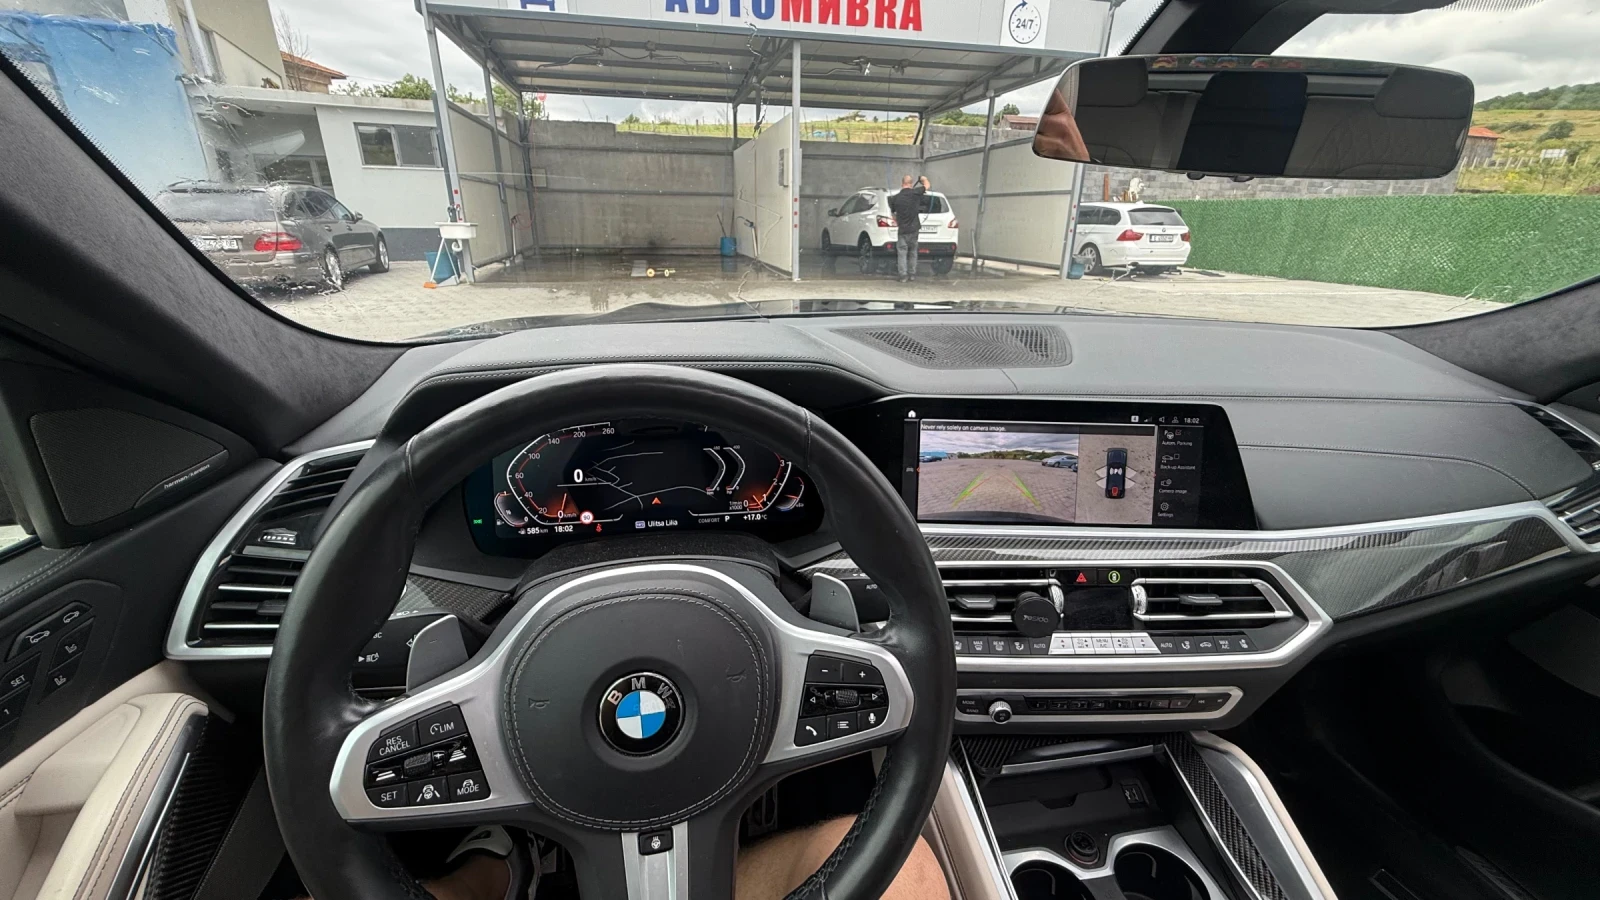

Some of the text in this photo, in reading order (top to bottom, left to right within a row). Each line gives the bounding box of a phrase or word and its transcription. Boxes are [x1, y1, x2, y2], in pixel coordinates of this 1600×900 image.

[1015, 18, 1034, 30] 24/7
[602, 427, 615, 435] 260
[573, 468, 584, 483] 0
[557, 510, 564, 519] 0
[743, 513, 762, 521] +17.0
[527, 527, 540, 535] 585
[554, 525, 574, 533] 18:02
[10, 674, 26, 688] SET
[607, 676, 673, 705] BMW
[439, 721, 455, 734] LIM
[386, 735, 402, 746] RES
[379, 740, 411, 756] CANCEL
[457, 783, 480, 796] MODE
[380, 790, 398, 803] SET
